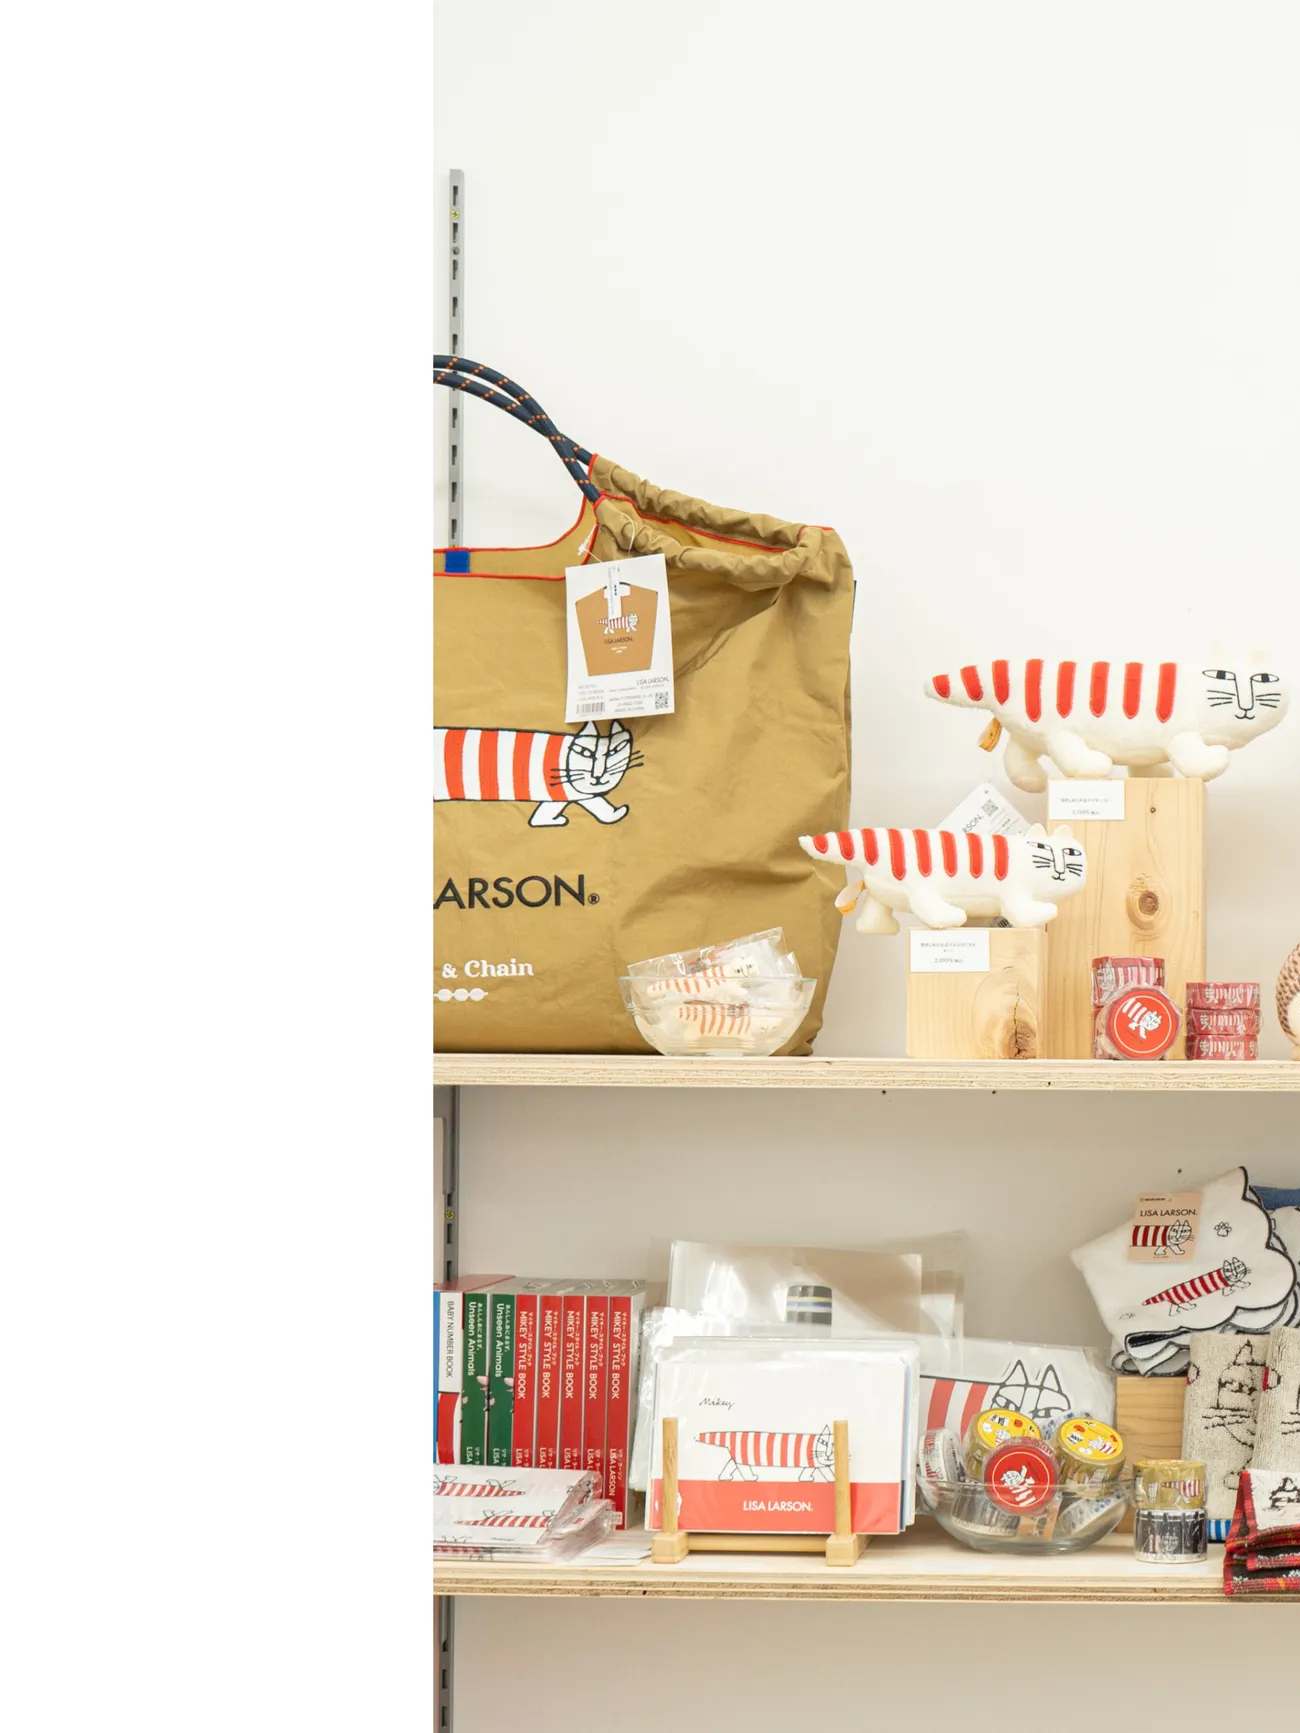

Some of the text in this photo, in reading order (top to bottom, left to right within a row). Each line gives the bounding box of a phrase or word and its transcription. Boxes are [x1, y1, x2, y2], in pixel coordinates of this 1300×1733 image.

[441, 957, 534, 979] & Chain
[1140, 1209, 1159, 1217] LISA
[445, 1300, 455, 1378] BABY NUMBER BOOK
[467, 1302, 477, 1376] Unseen Animals
[494, 1303, 505, 1378] Unseen Animals
[517, 1310, 528, 1399] MIKEY STYLE BOOK
[541, 1310, 552, 1398] MIKEY STYLE BOOK
[565, 1310, 575, 1399] MIKEY STYLE BOOK
[588, 1311, 599, 1400] MIKEY STYLE BOOK
[611, 1311, 621, 1400] MIKEY STYLE BOOK
[699, 1397, 735, 1410] Mikey
[515, 1448, 523, 1465] LISA
[539, 1447, 547, 1464] LISA
[587, 1449, 595, 1465] LISA
[608, 1448, 617, 1496] LISA LARSON
[743, 1500, 767, 1511] LISA
